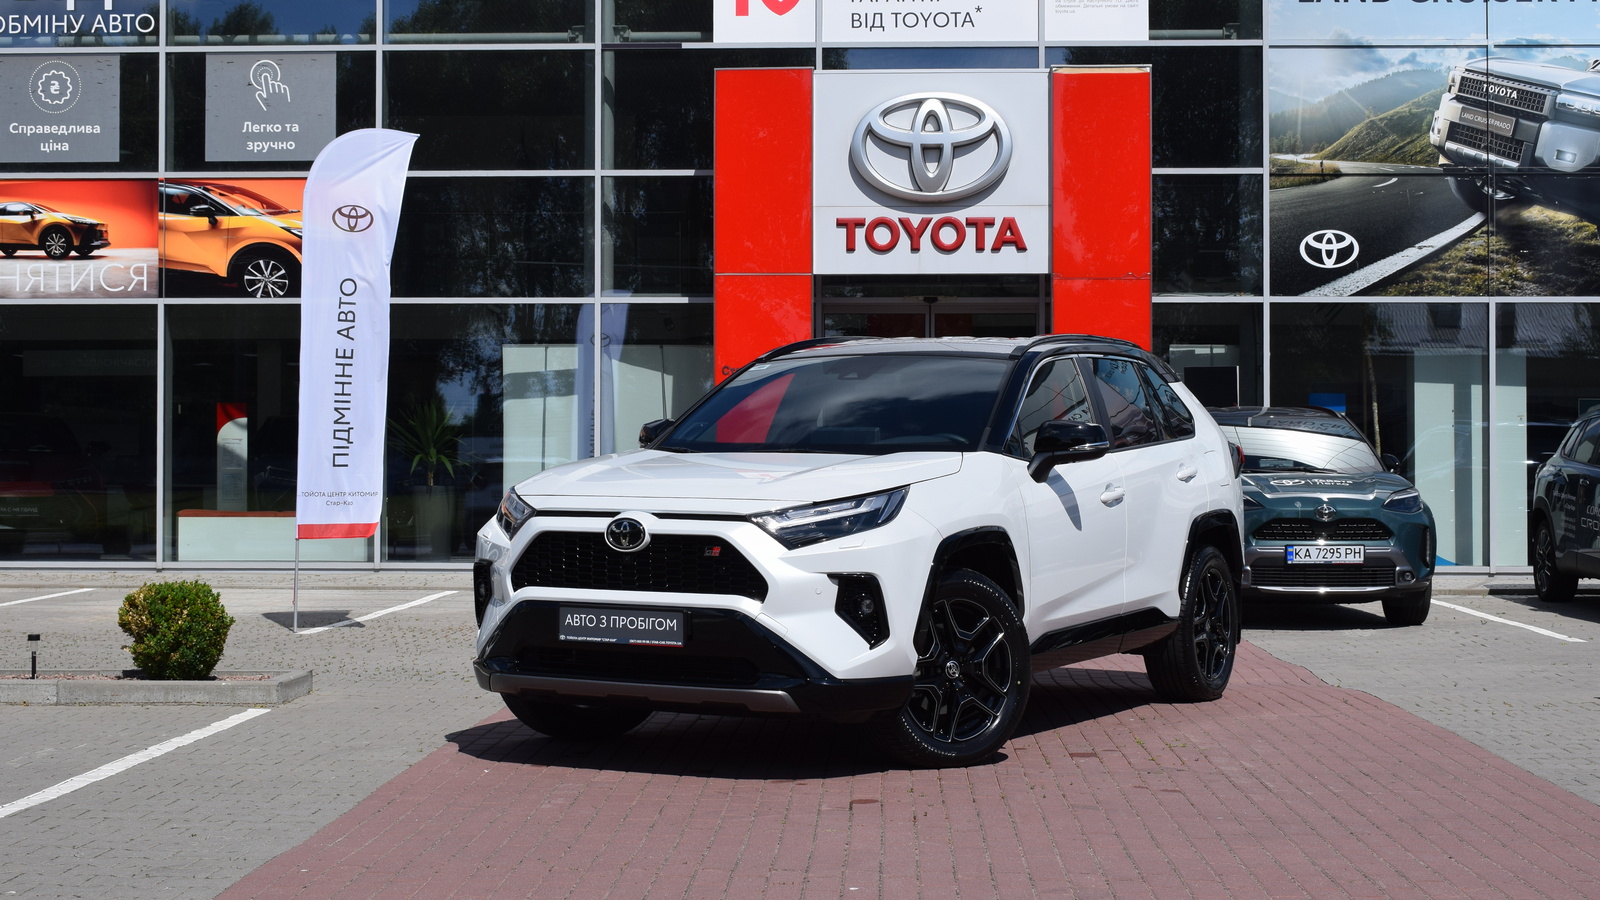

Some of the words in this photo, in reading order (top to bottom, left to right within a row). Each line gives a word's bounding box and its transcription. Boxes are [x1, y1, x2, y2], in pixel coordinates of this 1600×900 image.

[91, 13, 155, 33] АВТО
[850, 12, 885, 32] ВІД
[1483, 84, 1518, 100] TOYOTA
[9, 122, 101, 135] Справедлива
[242, 122, 283, 133] Легко
[285, 123, 300, 133] та
[1461, 112, 1474, 120] LAND
[1495, 120, 1511, 130] PRADO
[40, 139, 69, 152] ціна
[246, 141, 296, 153] зручно
[836, 216, 1028, 252] TOYOTA
[336, 277, 358, 342] АВТО
[332, 347, 355, 468] ПІДМІННЕ
[1295, 548, 1312, 560] KA
[1315, 548, 1342, 560] 7295
[1345, 548, 1362, 560] PH
[564, 613, 597, 627] АВТО
[610, 616, 678, 631] ПРОБІГОМ
